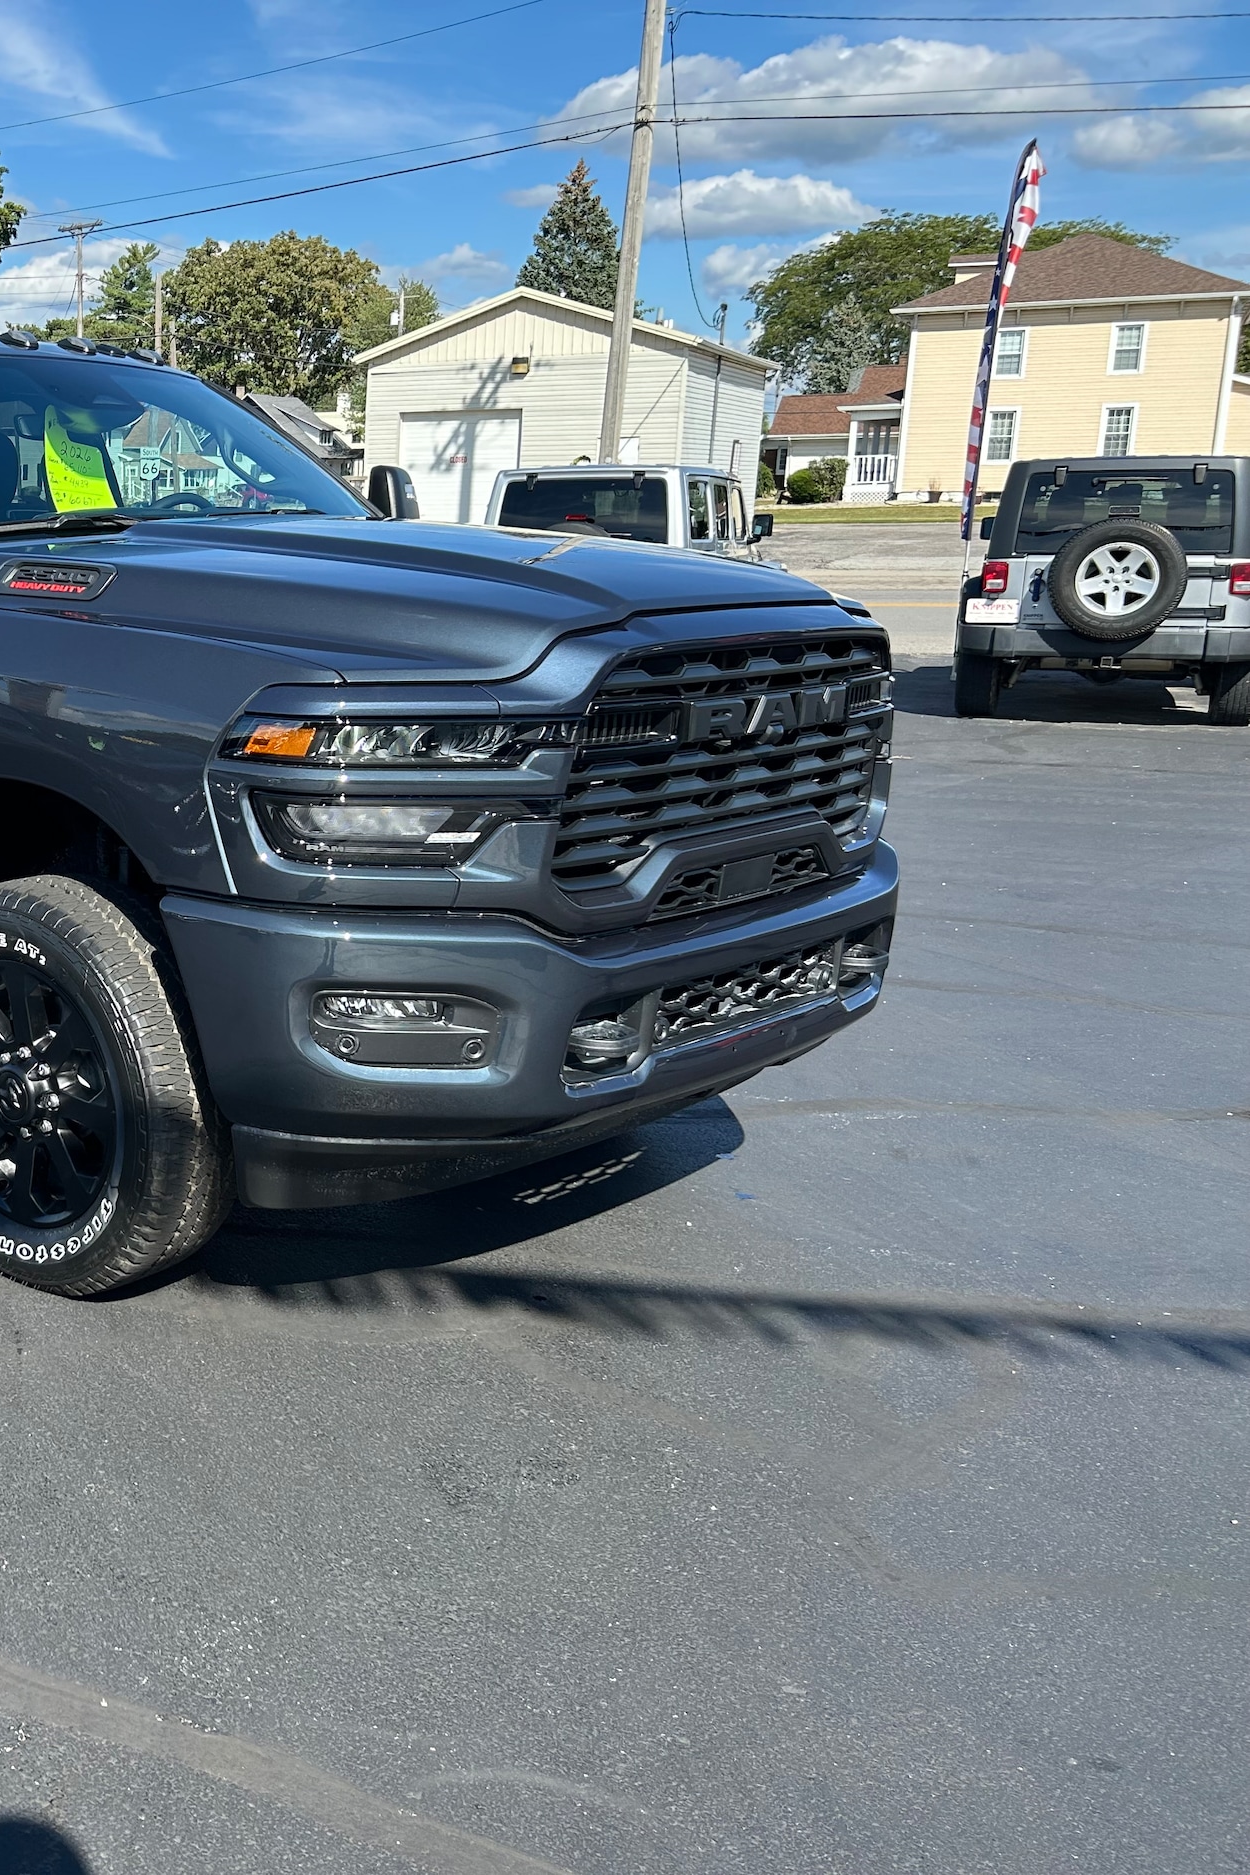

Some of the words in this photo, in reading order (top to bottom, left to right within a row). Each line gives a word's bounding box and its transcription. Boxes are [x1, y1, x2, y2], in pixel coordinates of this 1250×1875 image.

[60, 441, 92, 462] 2026
[142, 462, 158, 475] 66
[15, 567, 96, 585] 2500
[9, 580, 51, 591] HEAVY
[49, 583, 88, 594] DUTY
[688, 684, 847, 743] RAM
[306, 844, 344, 852] RAM
